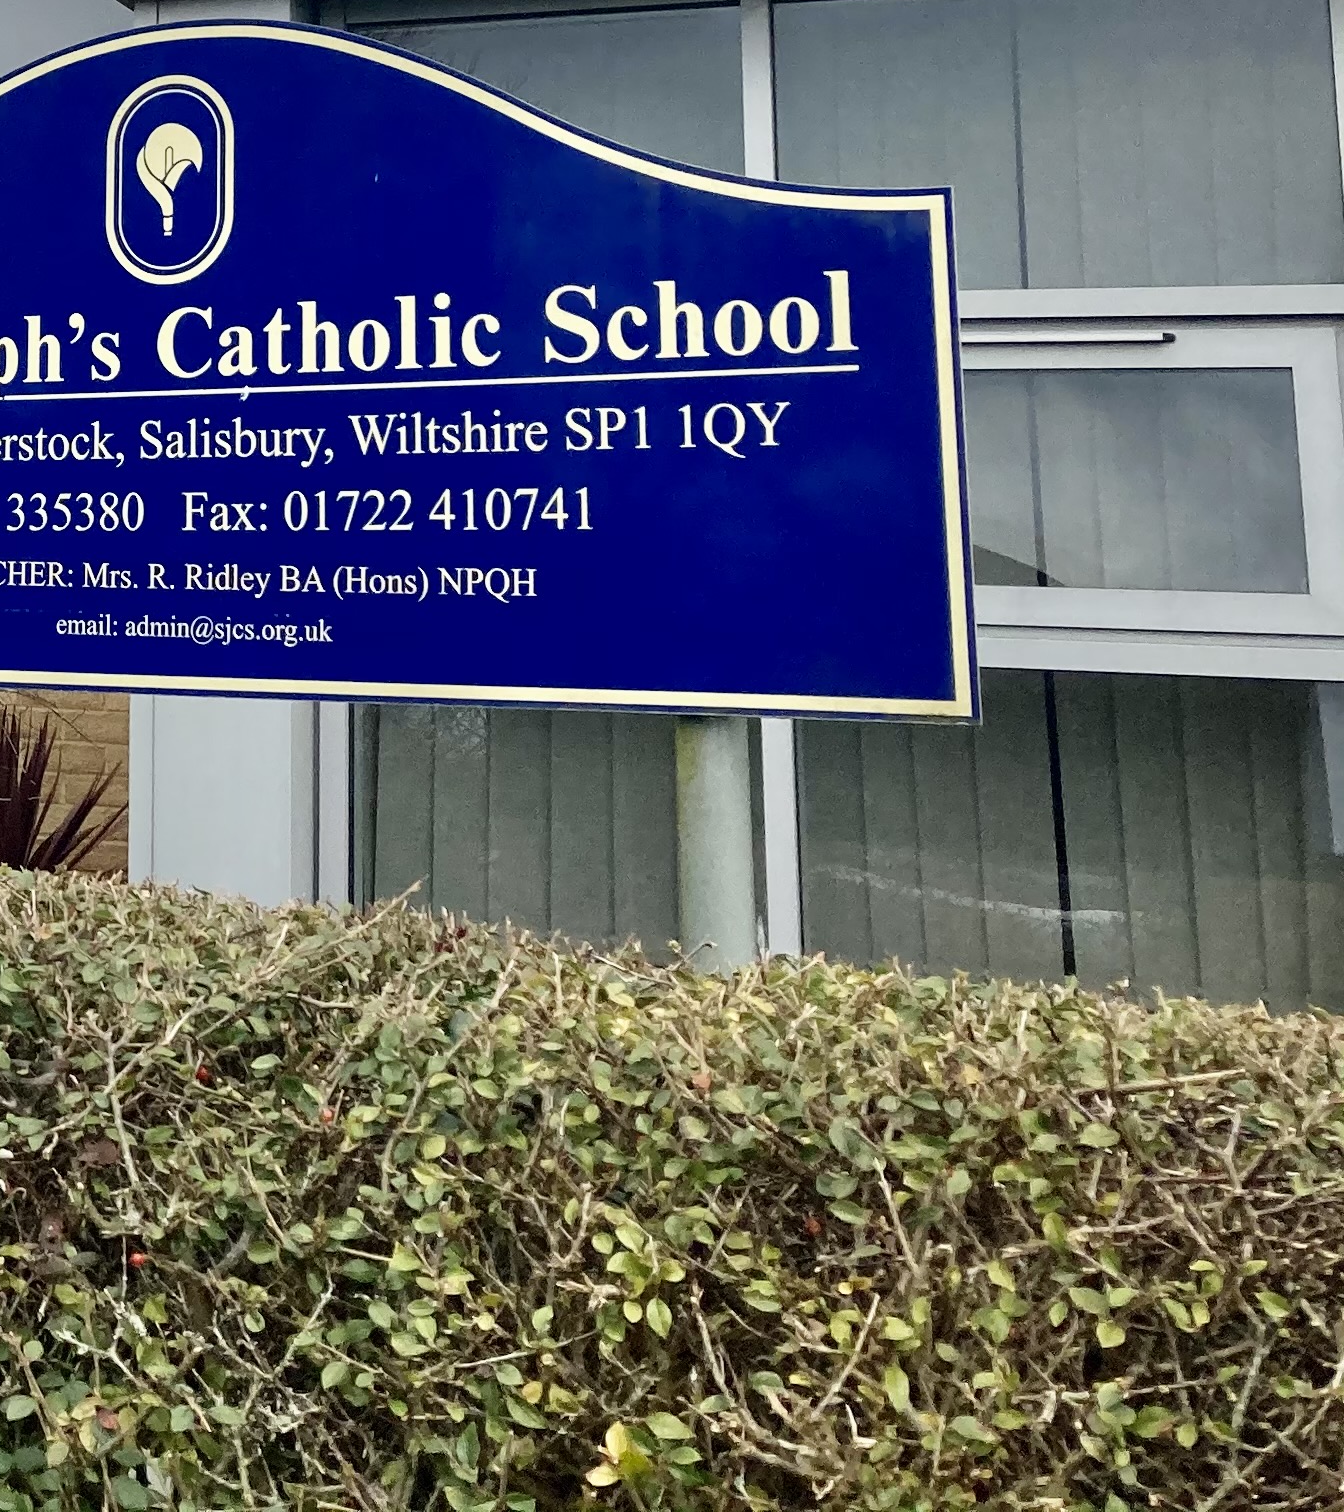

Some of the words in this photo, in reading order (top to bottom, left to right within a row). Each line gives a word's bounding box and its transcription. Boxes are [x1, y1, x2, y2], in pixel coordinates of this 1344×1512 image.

[157, 293, 501, 378] Catholic
[545, 270, 859, 363] School
[140, 417, 333, 467] Salisbury,
[348, 410, 548, 455] Wiltshire
[566, 406, 651, 450] SP1
[679, 402, 790, 458] 1QY
[7, 492, 144, 531] 335380
[182, 492, 267, 531] Fax:
[284, 489, 413, 531] 01722
[429, 487, 593, 530] 410741
[82, 562, 138, 588] Mrs.
[147, 564, 174, 589] R.
[185, 563, 271, 598] Ridley
[280, 565, 325, 592] BA
[333, 566, 428, 602] (Hons)
[437, 568, 537, 603] NPQH
[56, 614, 117, 636] email:
[125, 614, 333, 647] admin@sjcs.org.uk
